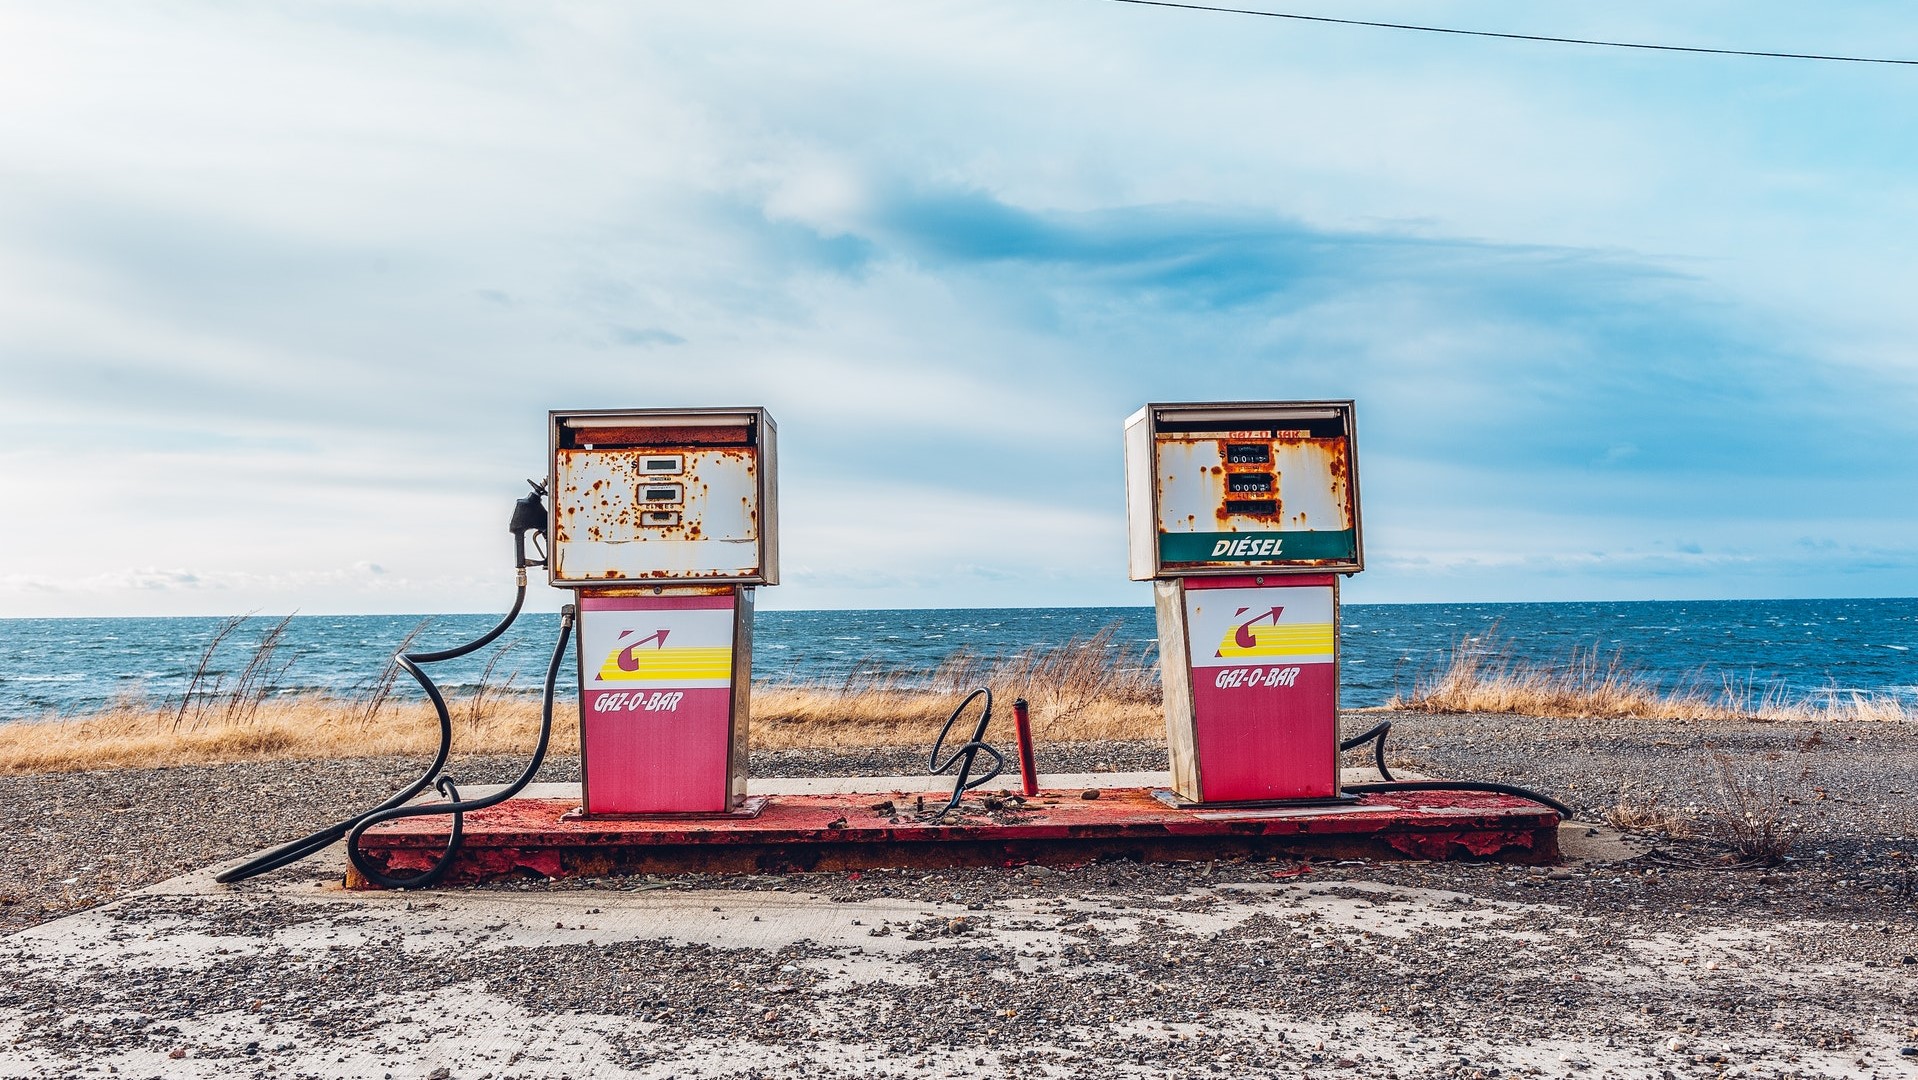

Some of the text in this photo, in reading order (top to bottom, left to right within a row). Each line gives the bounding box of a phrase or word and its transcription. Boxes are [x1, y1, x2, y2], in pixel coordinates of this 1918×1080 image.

[1211, 535, 1283, 557] DIÉSEL
[1215, 667, 1301, 690] GAZ-O-BAR
[594, 691, 684, 713] GAZ-O-BAR
